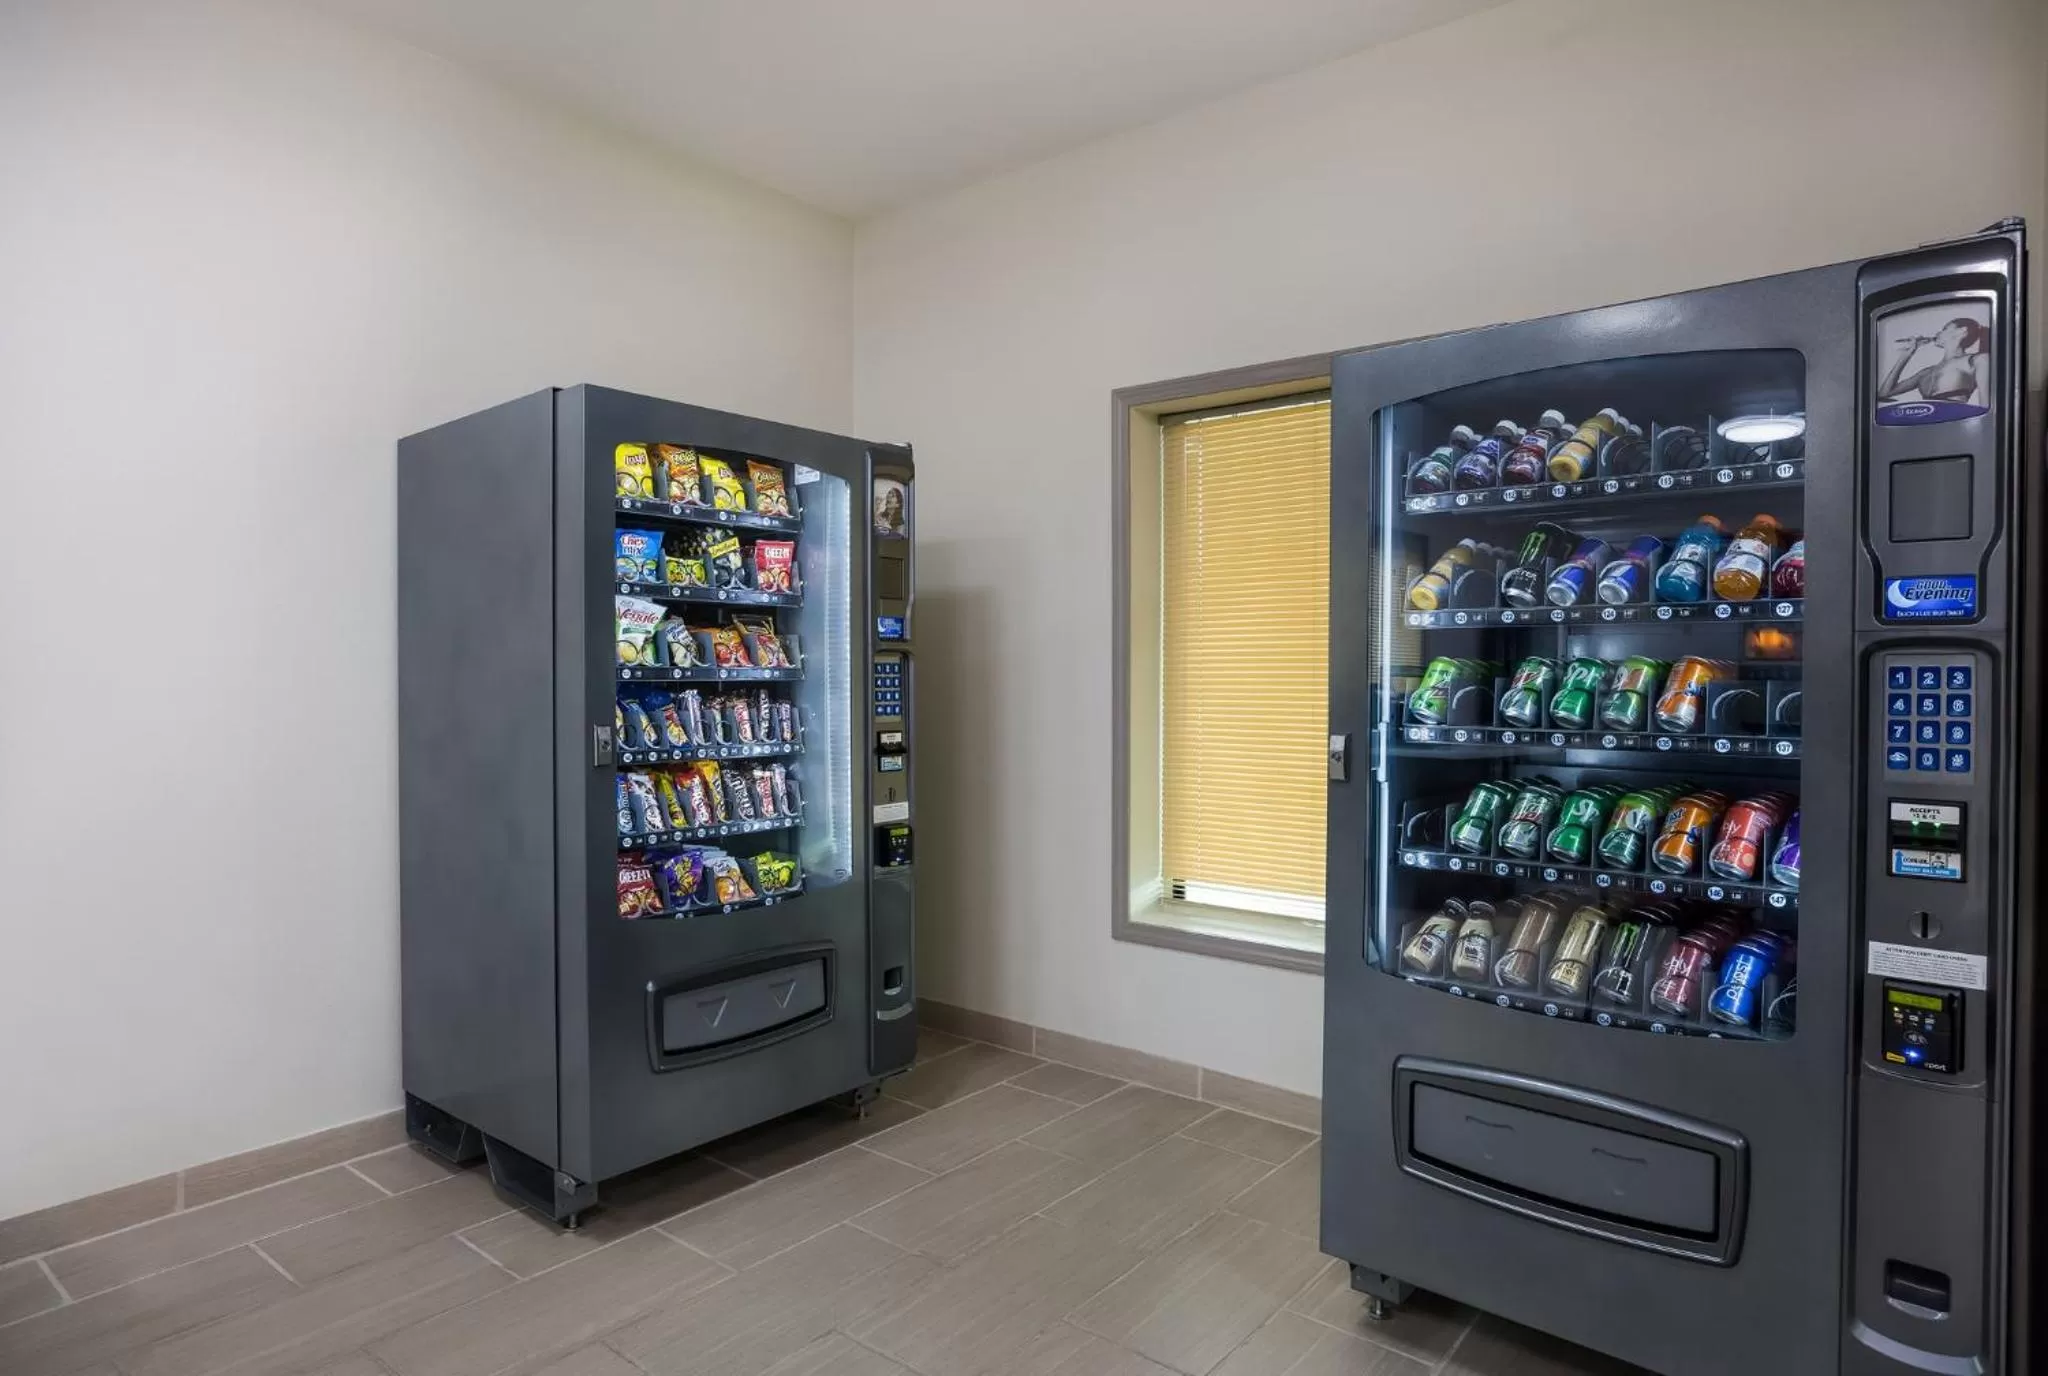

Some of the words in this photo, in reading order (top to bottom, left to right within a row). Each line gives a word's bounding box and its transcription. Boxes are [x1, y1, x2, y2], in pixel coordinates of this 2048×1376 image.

[1905, 587, 1971, 602] Evening
[616, 606, 660, 625] Veggie
[1896, 671, 1904, 685] 1
[1923, 671, 1934, 685] 2
[1953, 671, 1964, 685] 3
[1923, 698, 1934, 712] 5
[1893, 725, 1904, 738] 7
[1922, 726, 1934, 739] 8
[1922, 753, 1933, 766] 0
